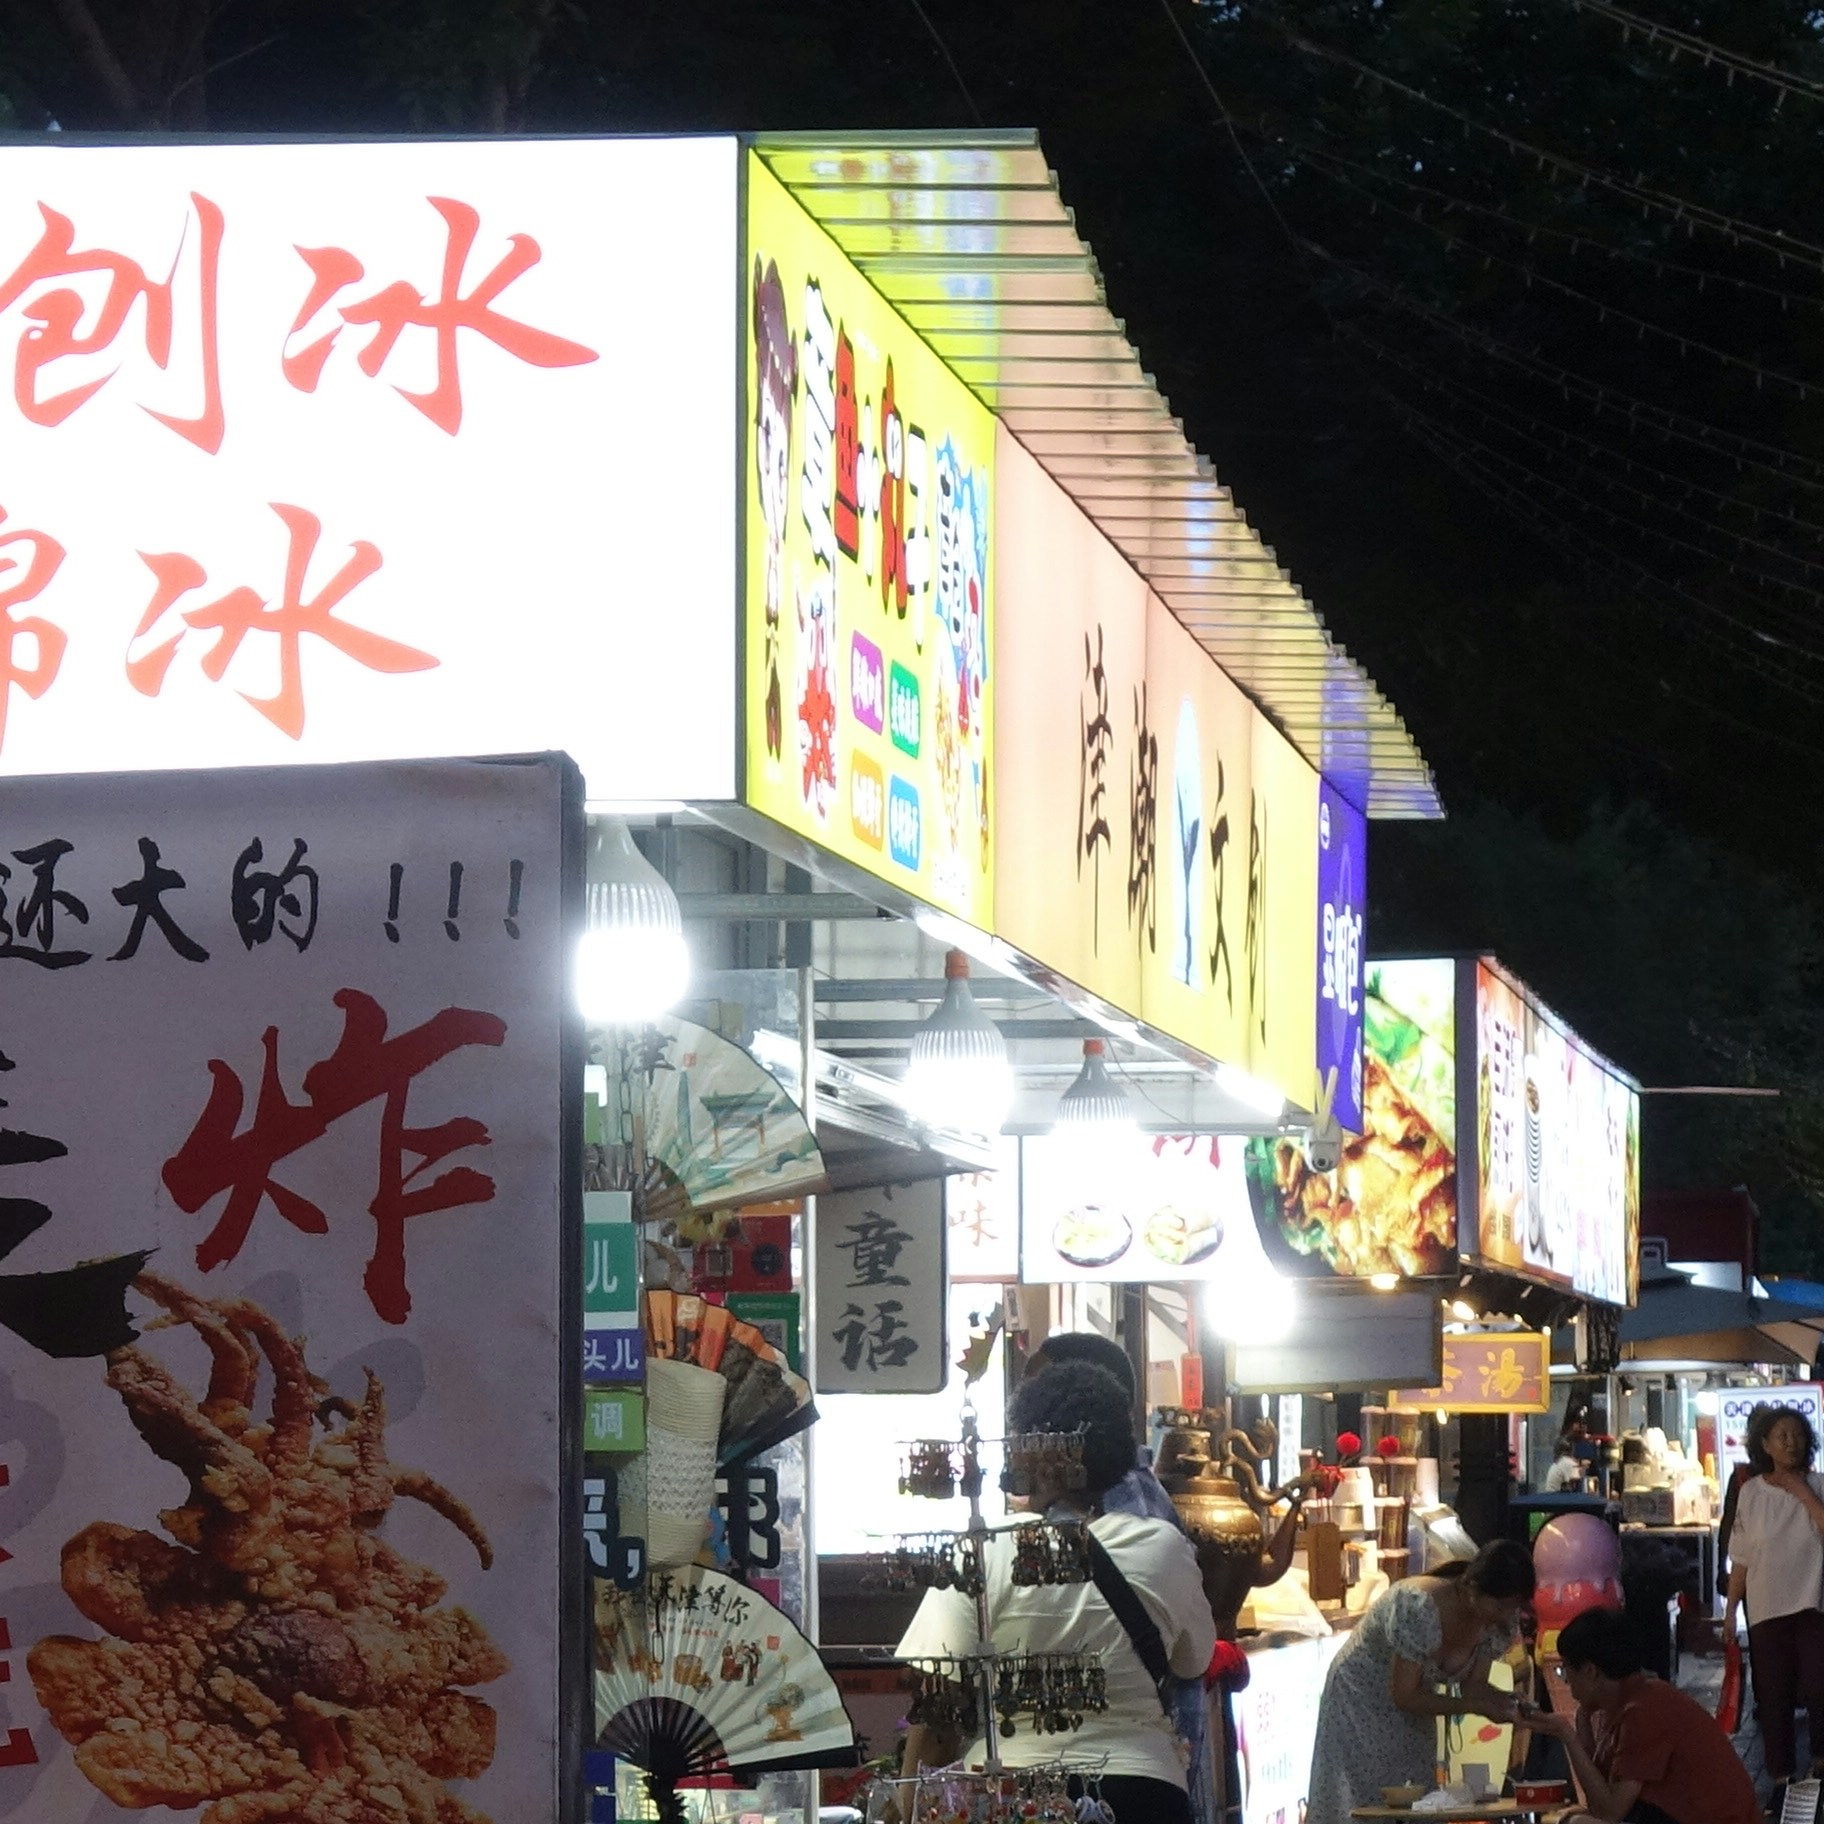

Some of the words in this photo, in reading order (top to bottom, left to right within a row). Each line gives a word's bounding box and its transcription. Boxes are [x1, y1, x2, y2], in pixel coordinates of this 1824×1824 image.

[800, 272, 932, 655] 章鱼小丸子
[831, 1185, 920, 1374] 童话
